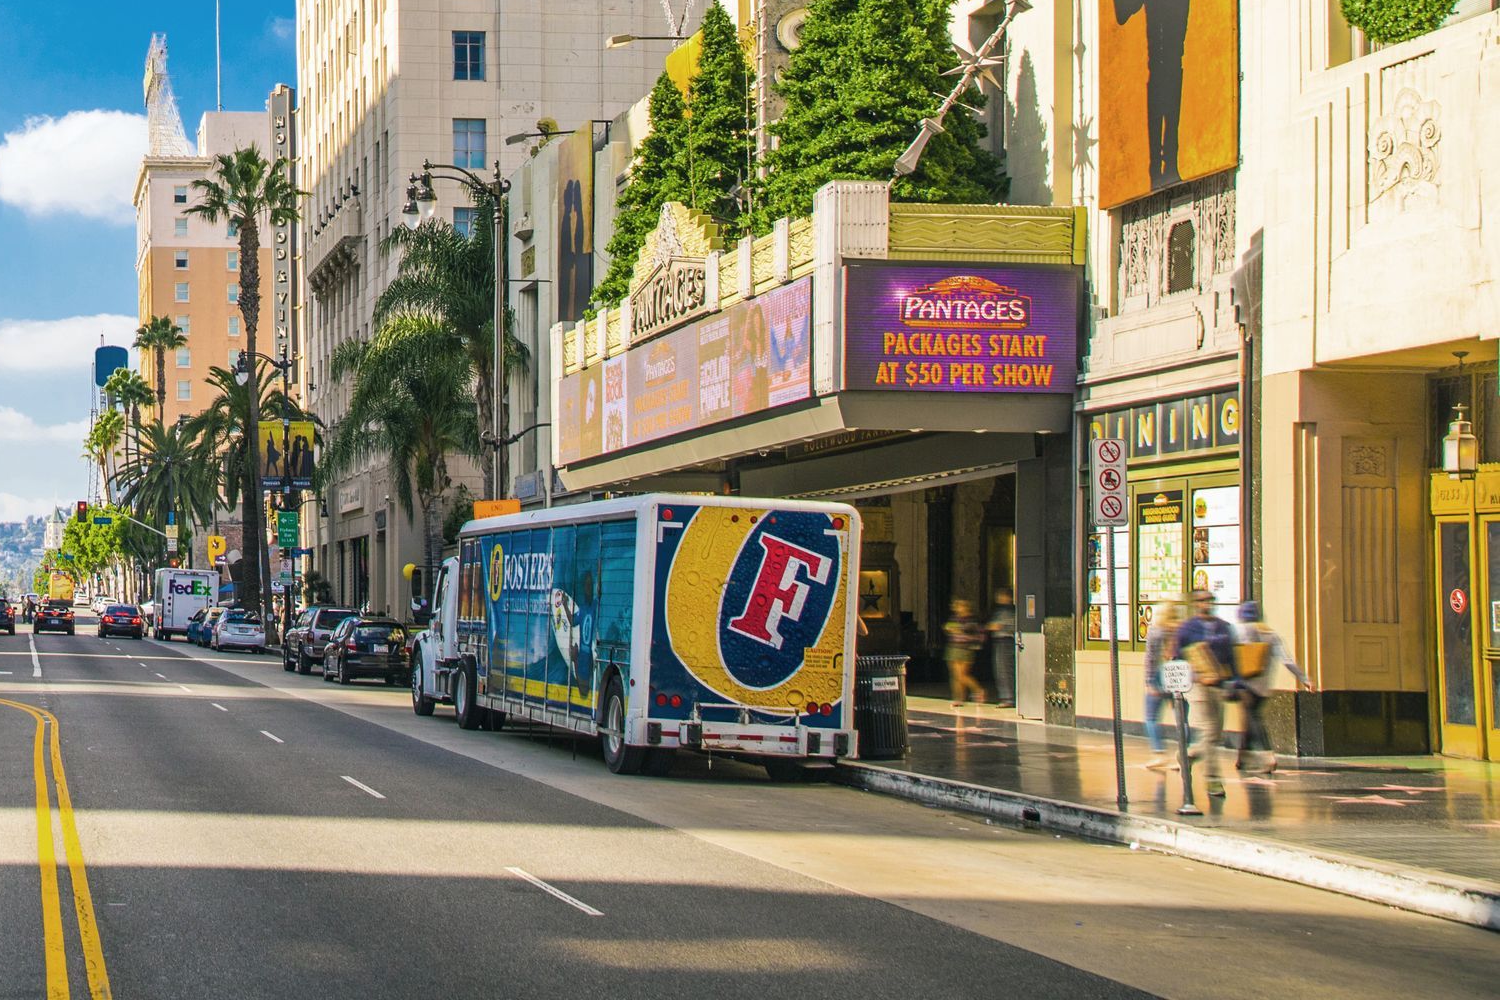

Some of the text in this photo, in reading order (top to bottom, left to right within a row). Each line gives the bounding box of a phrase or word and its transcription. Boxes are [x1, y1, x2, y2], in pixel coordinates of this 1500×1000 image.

[904, 296, 1025, 321] PANTAGES
[883, 332, 1047, 357] PACKAGES START
[875, 361, 1053, 387] AT $50 PER SHOW
[503, 552, 555, 591] FOSTER'S
[169, 579, 212, 597] FedEx
[727, 531, 833, 650] F
